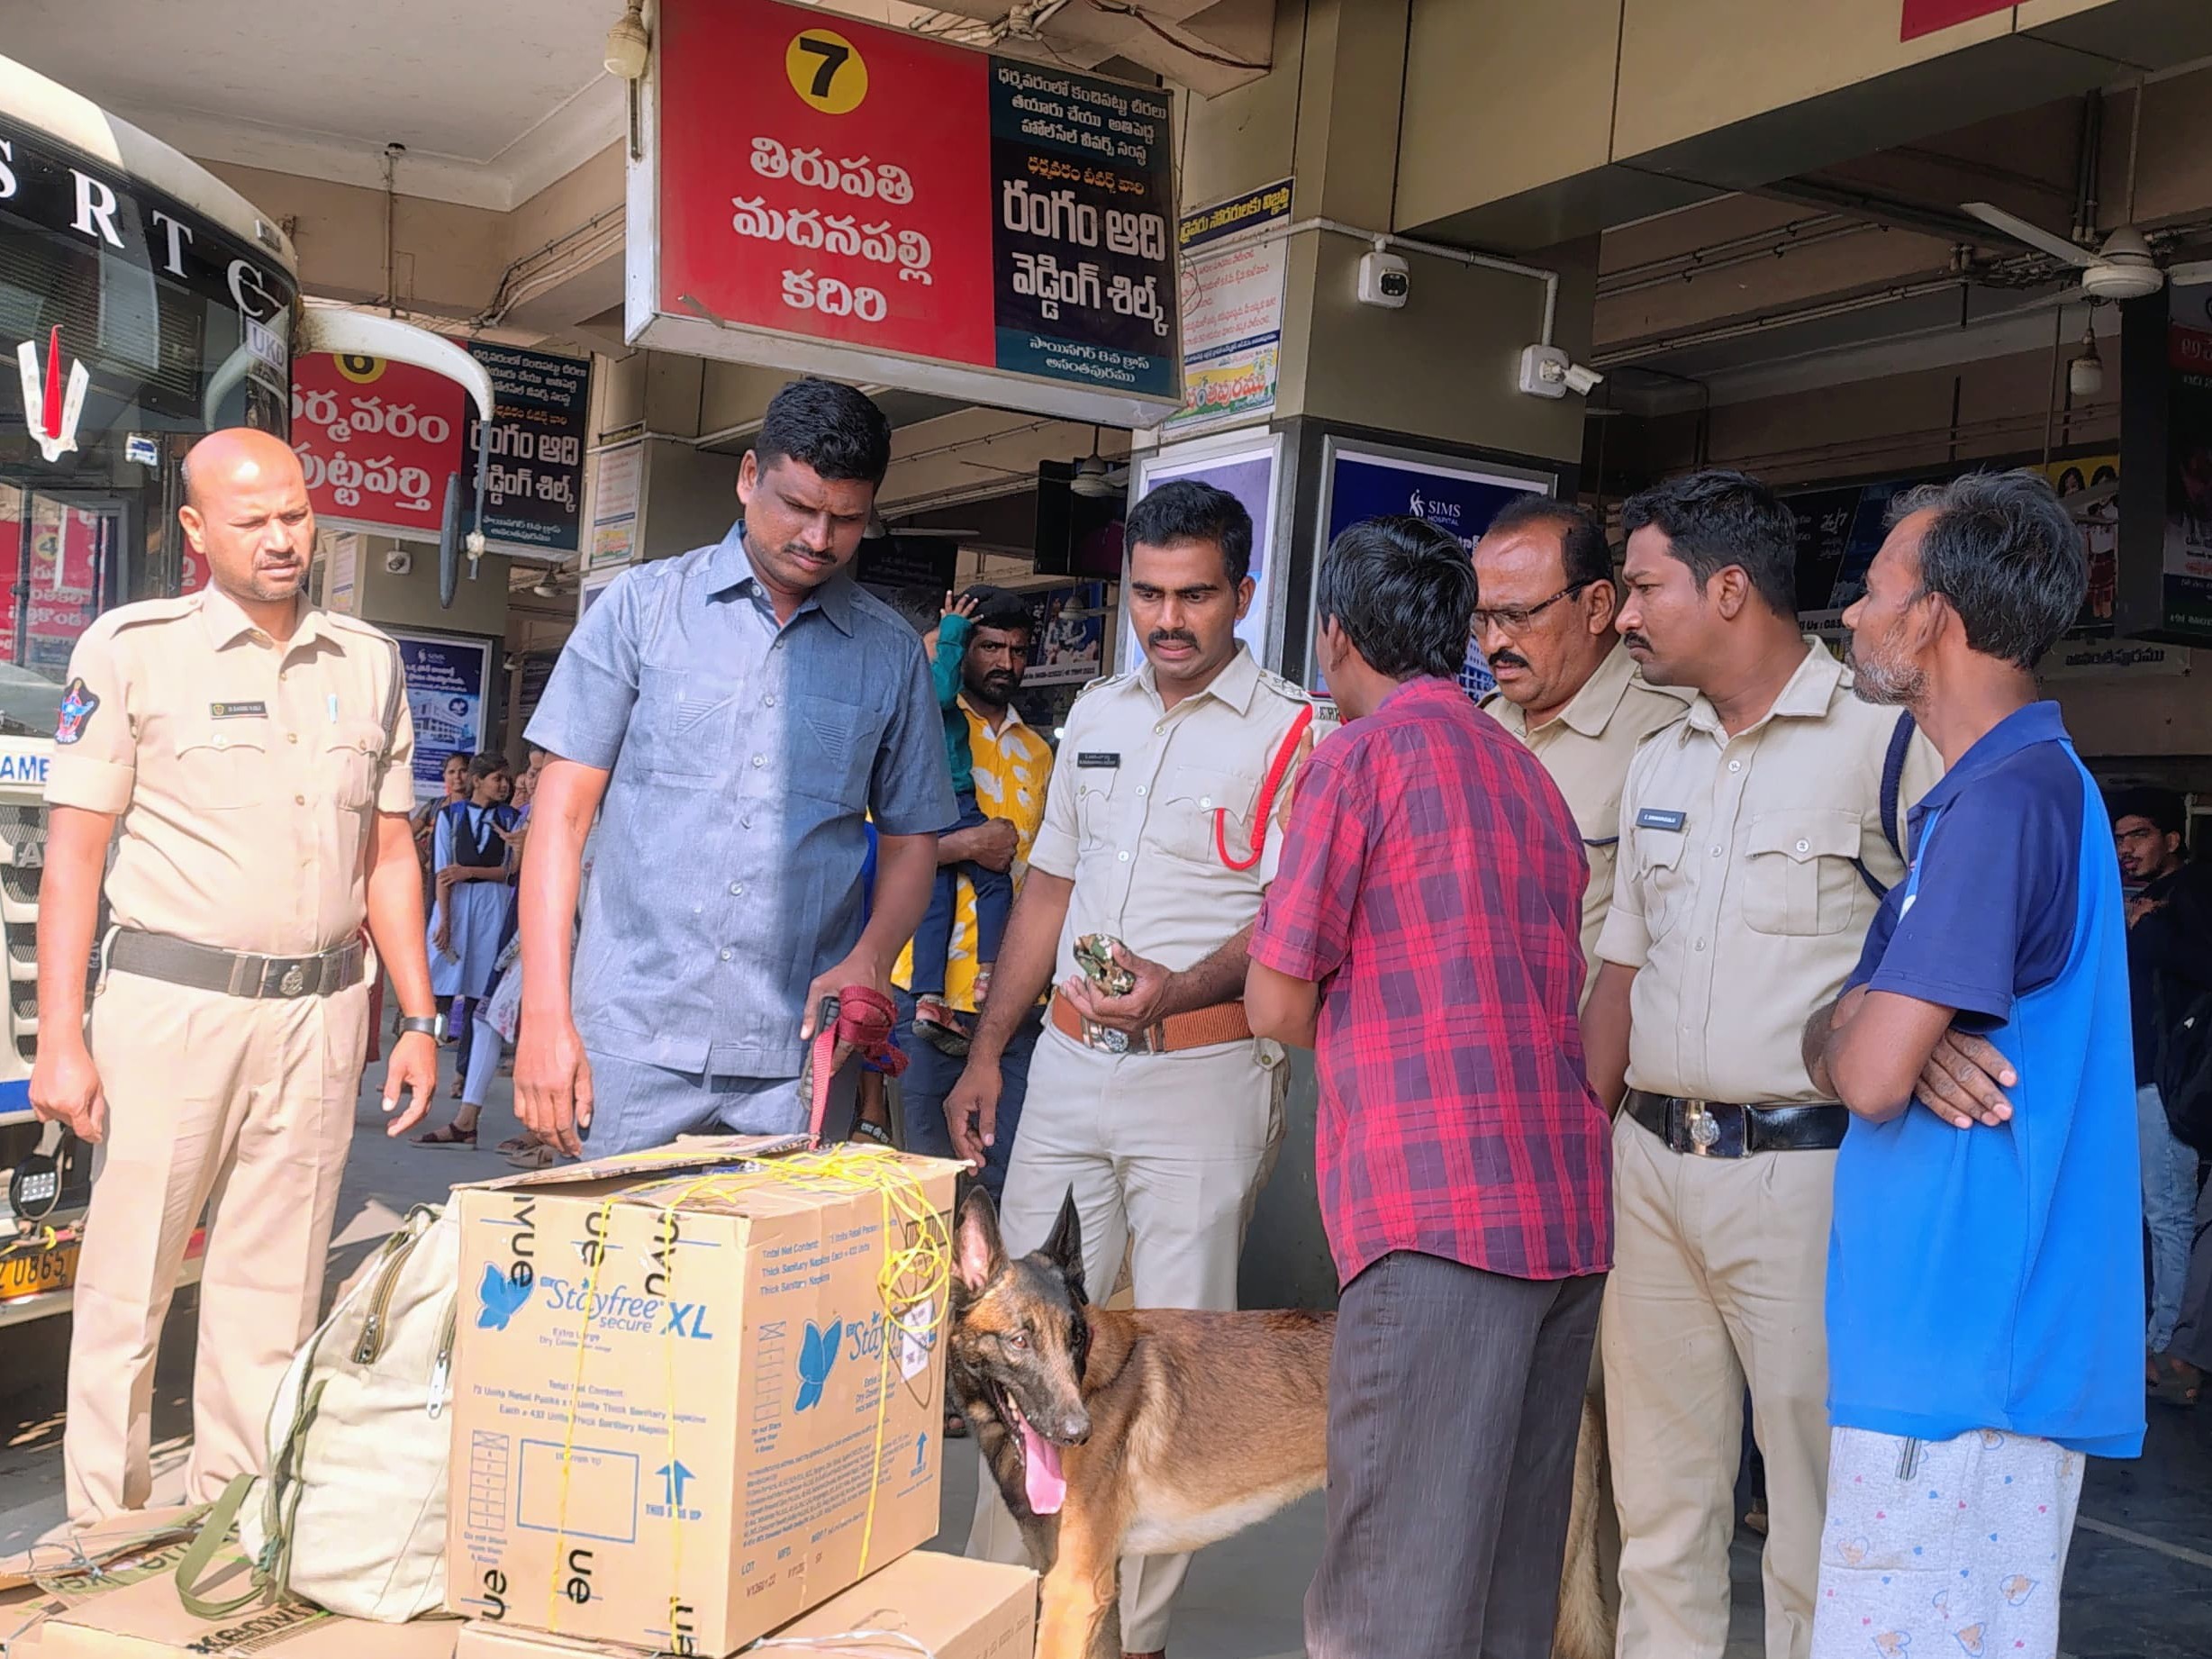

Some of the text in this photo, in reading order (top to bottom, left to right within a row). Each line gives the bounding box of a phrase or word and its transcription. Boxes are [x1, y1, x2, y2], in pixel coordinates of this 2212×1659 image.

[800, 37, 848, 97] 7
[750, 137, 914, 204] తిరుపతి
[731, 195, 933, 286] మదనపల్లి
[1003, 178, 1098, 248] రంగం
[1105, 209, 1165, 261] ఆది
[782, 268, 887, 322] కదిరి
[1011, 251, 1101, 321] వెడ్డింగ్
[1427, 514, 1459, 526] HOSPITAL
[1428, 500, 1461, 518] SIMS
[547, 1279, 713, 1340] Stayfree XL
[576, 1330, 601, 1342] Lrge
[599, 1316, 652, 1333] secure
